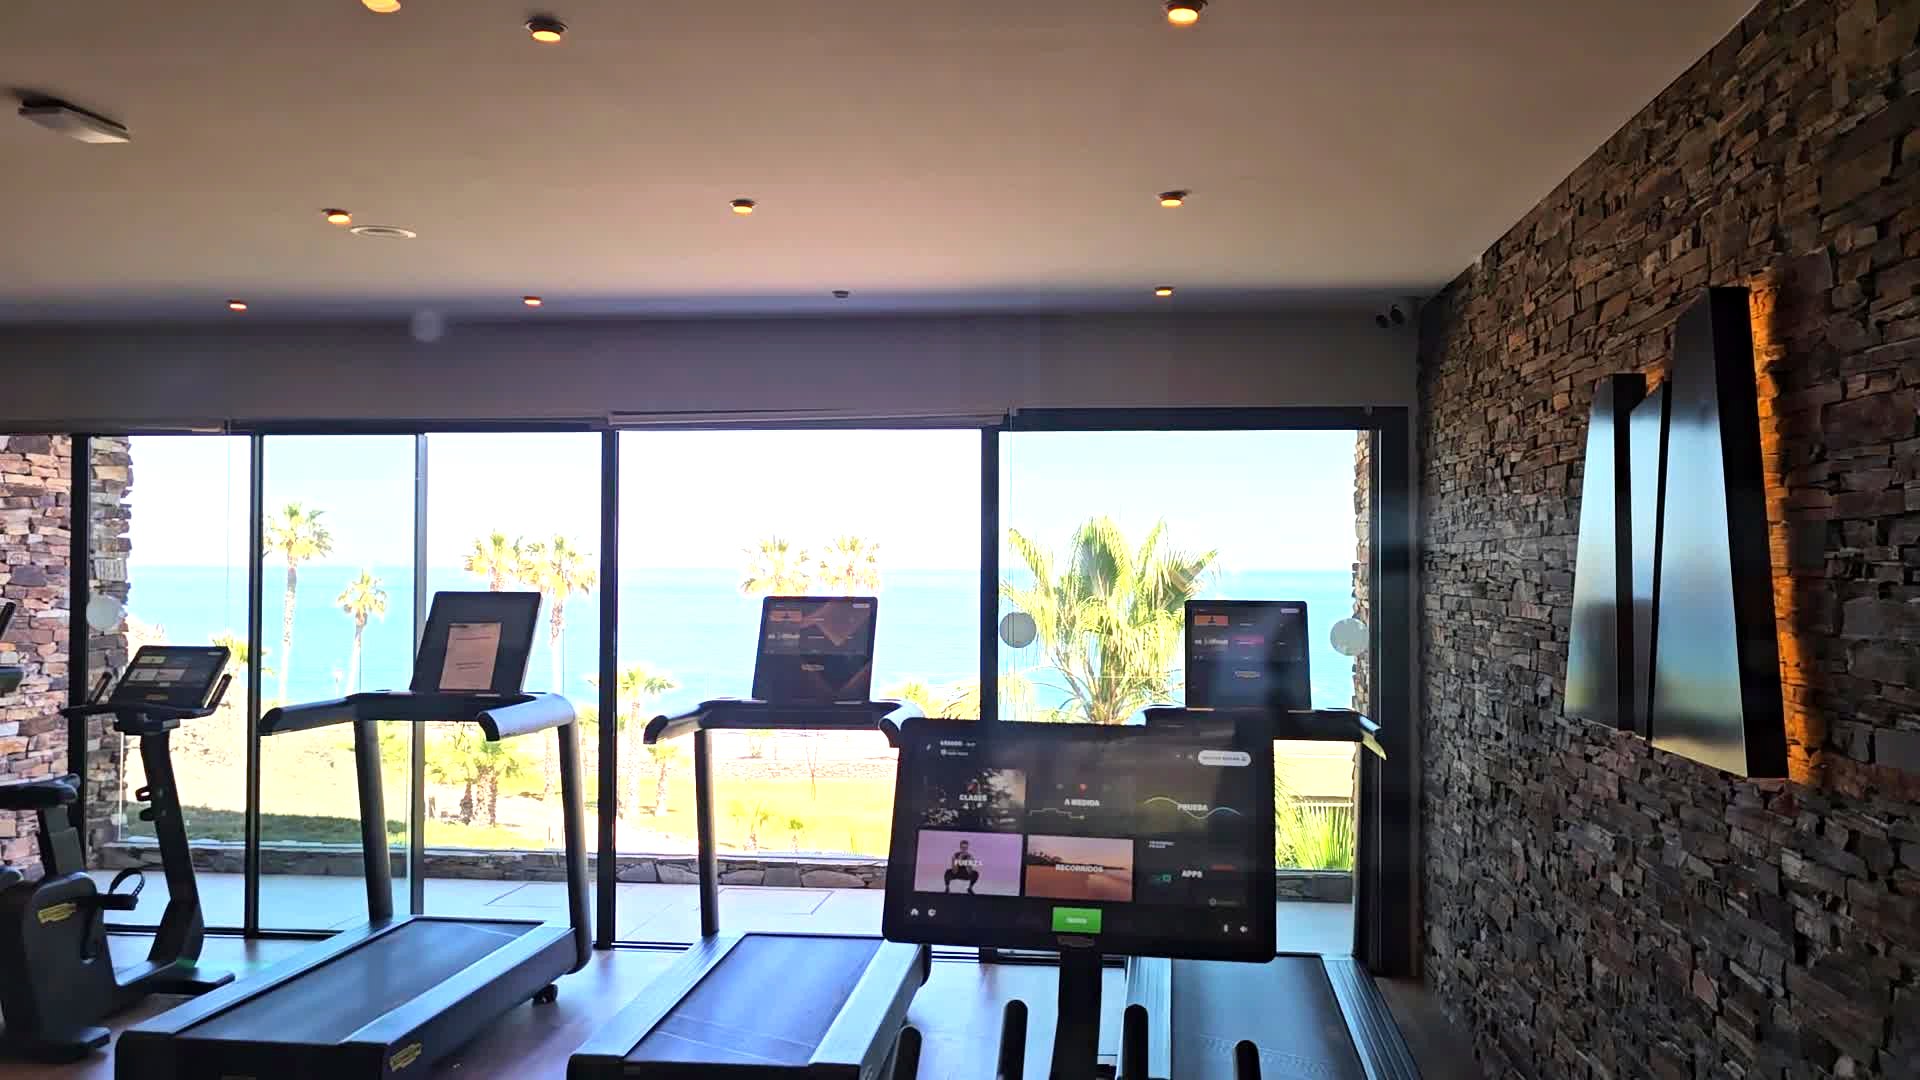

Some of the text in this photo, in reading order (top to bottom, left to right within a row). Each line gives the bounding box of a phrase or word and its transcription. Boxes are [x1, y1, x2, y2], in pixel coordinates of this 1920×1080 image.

[959, 794, 988, 802] CLASES
[1064, 798, 1100, 807] A MEDIDA
[1177, 803, 1209, 812] PRUEBA
[1055, 863, 1104, 873] RECORRIDOS
[1181, 869, 1203, 878] APPS
